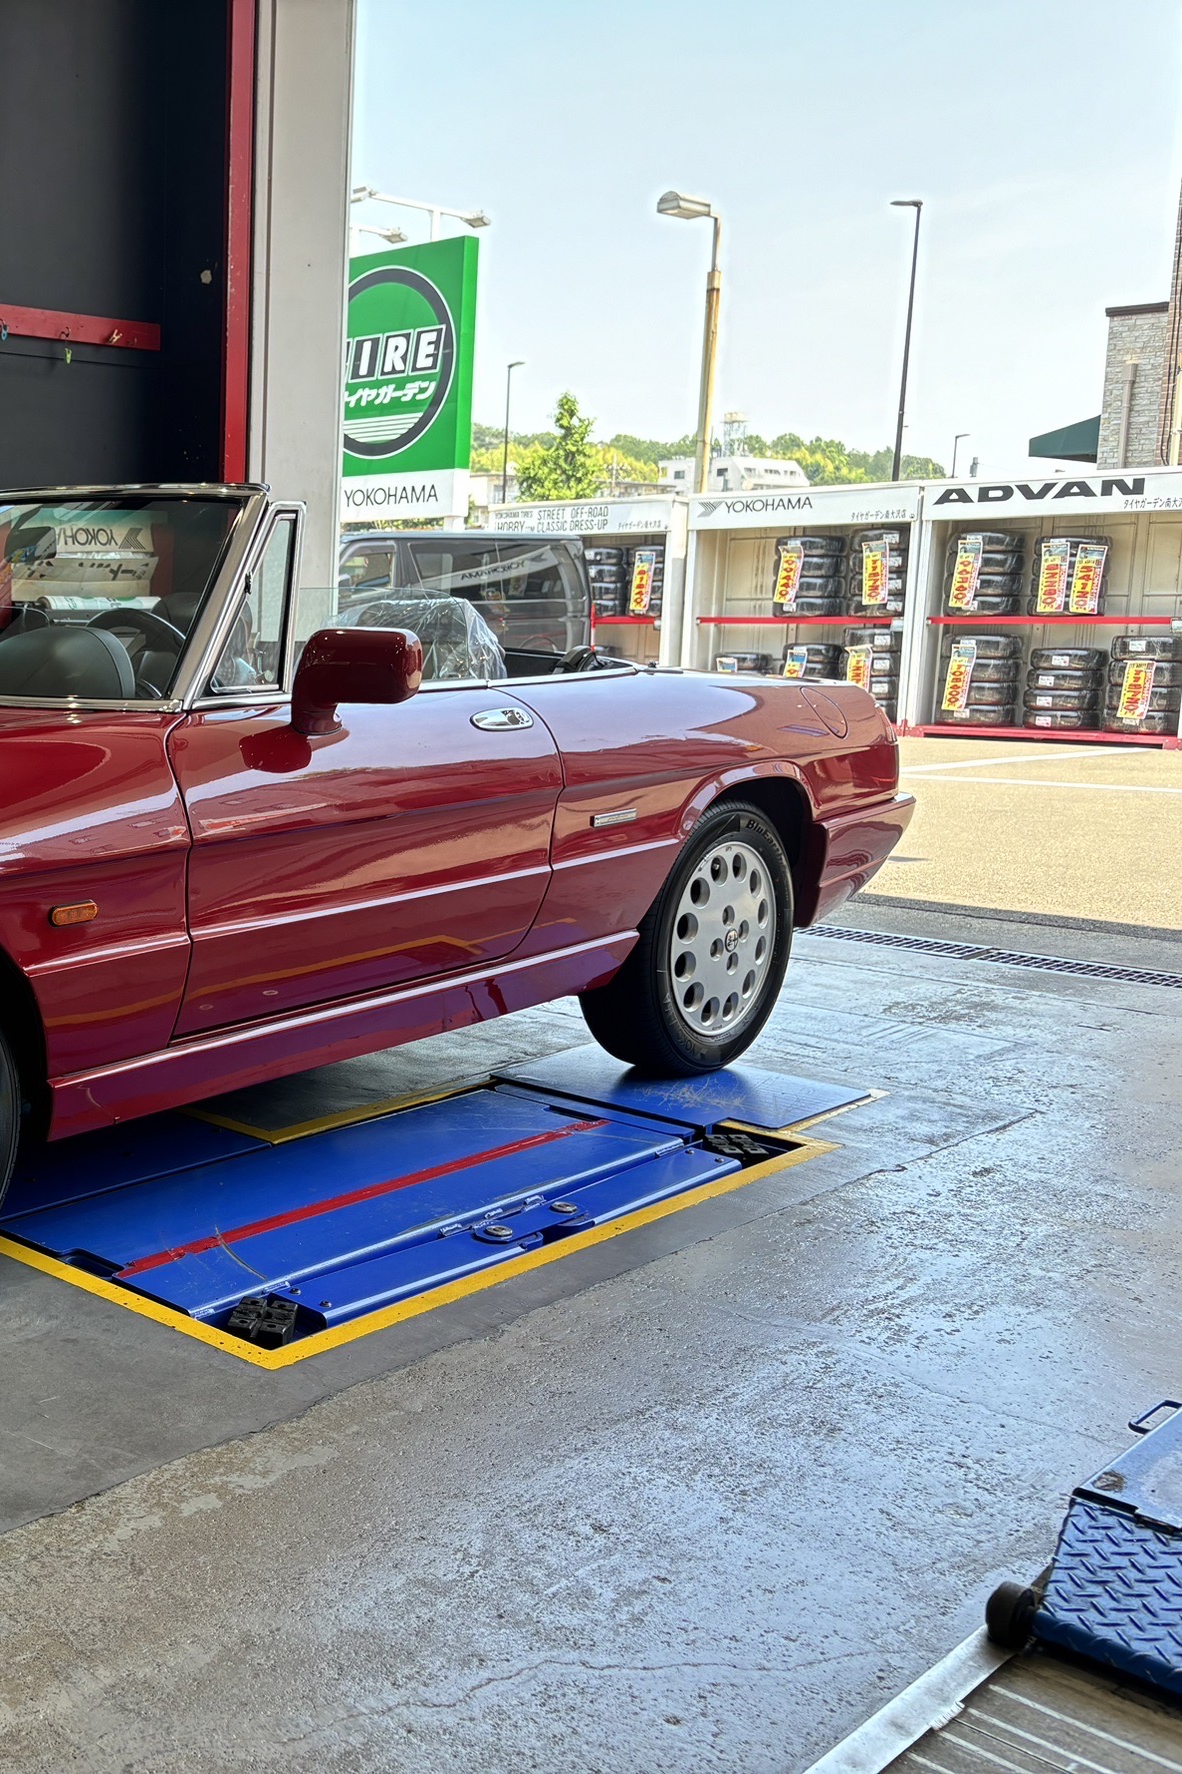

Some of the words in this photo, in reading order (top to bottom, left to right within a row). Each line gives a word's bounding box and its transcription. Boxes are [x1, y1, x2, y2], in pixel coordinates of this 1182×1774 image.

[346, 331, 440, 378] IRE
[344, 484, 439, 508] YOKOHAMA
[933, 477, 1146, 506] ADVAN
[537, 509, 566, 521] STREET
[571, 506, 609, 519] OFF-ROAD
[725, 496, 813, 514] YOKOHAMA
[570, 519, 609, 532] DRESS-UP
